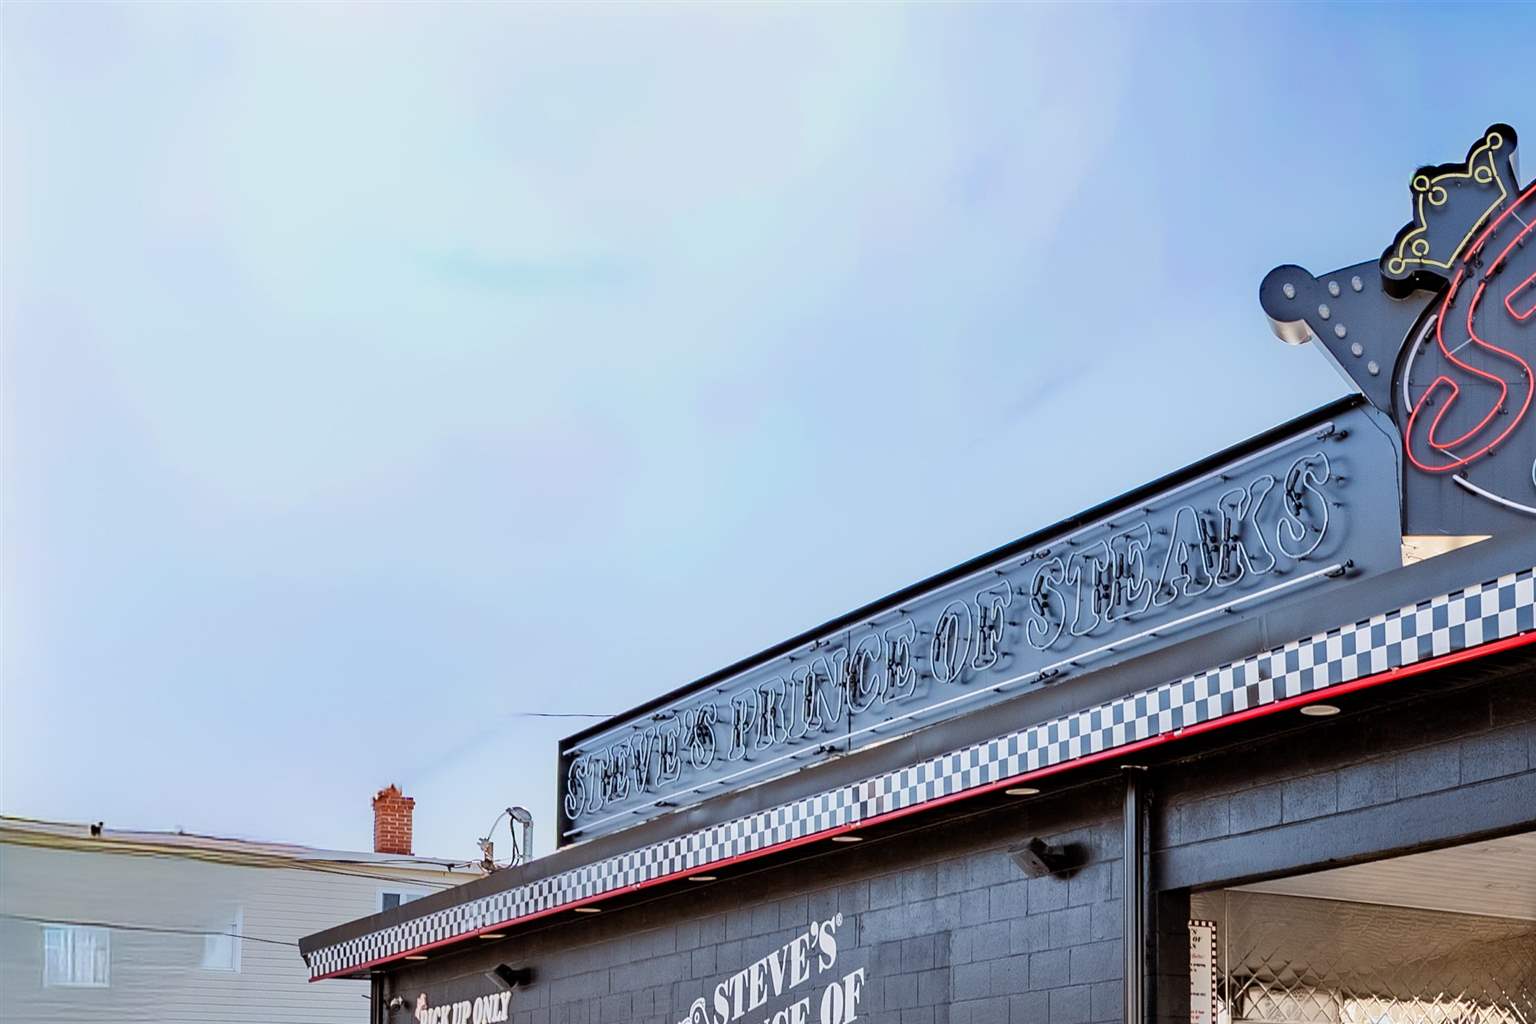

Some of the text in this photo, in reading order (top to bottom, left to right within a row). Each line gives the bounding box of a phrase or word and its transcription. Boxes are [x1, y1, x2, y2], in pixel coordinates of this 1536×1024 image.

[565, 451, 1333, 820] STEVE'S PRINCE OF STEAKS
